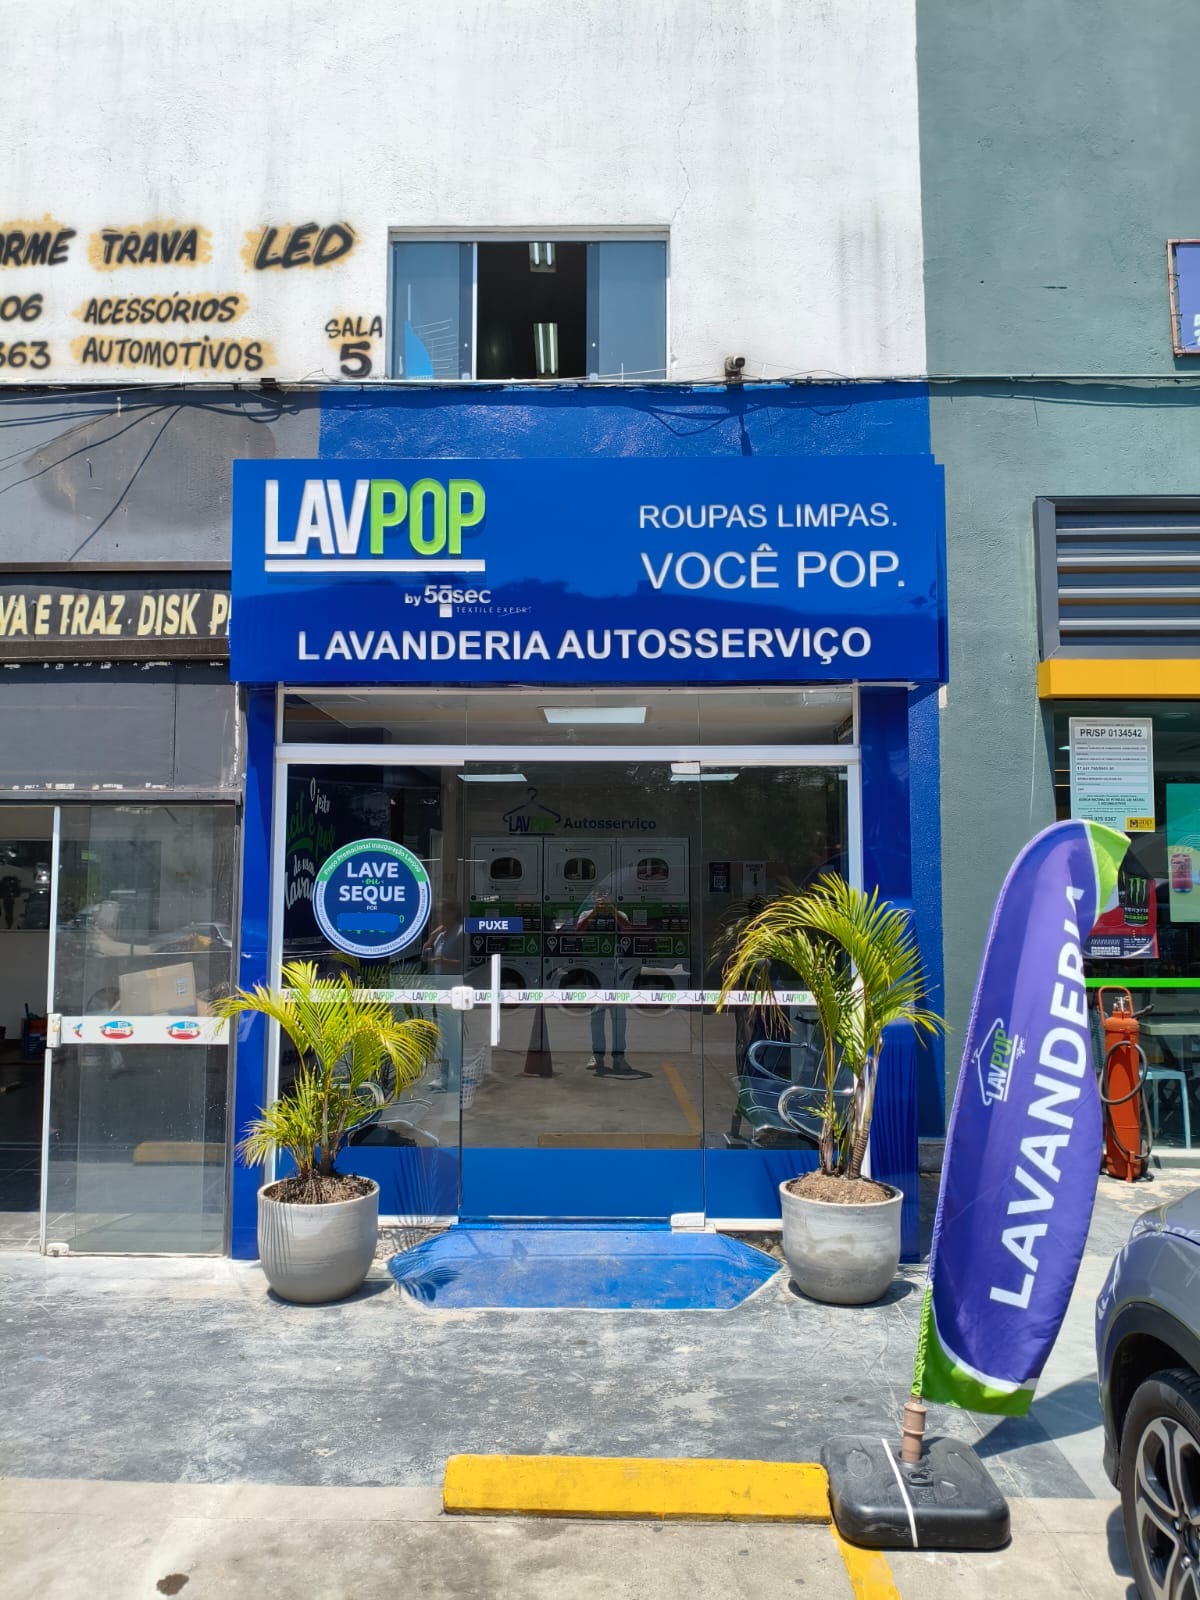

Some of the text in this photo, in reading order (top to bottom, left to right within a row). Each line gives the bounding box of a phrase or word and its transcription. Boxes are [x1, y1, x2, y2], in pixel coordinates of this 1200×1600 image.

[0, 222, 356, 270] RME TRAVA LED
[83, 291, 240, 325] ACESSÓRIOS
[324, 315, 384, 339] SALA
[81, 335, 264, 371] AUTOMOTIVOS
[339, 340, 373, 378] 5
[265, 478, 486, 555] LAVPOP
[639, 503, 898, 529] ROUPAS LIMPAS.
[640, 542, 905, 590] VOCÊ POP.
[34, 594, 52, 634] E
[59, 594, 126, 636] TRAZ
[136, 593, 201, 636] DISK
[209, 593, 232, 636] P
[404, 592, 421, 607] by
[298, 627, 872, 665] LAVANDERIA AUTOSSERVIÇO
[1080, 728, 1143, 737] PR/SP 0134542
[563, 817, 657, 831] Autosserviço
[323, 860, 339, 876] Preço
[337, 842, 372, 862] Promocional
[347, 862, 399, 878] LAVE
[339, 885, 406, 905] SEQUE
[478, 920, 509, 930] PUXE
[412, 991, 438, 1001] LAVPOP
[475, 991, 492, 1001] LAVP
[518, 991, 544, 1001] LAVPOP
[561, 991, 587, 1001] LAVPOP
[604, 991, 630, 1001] LAVPOP
[651, 992, 677, 1002] LAVPOP
[782, 993, 808, 1003] LAVPOP
[985, 1028, 1013, 1101] LAVPOP
